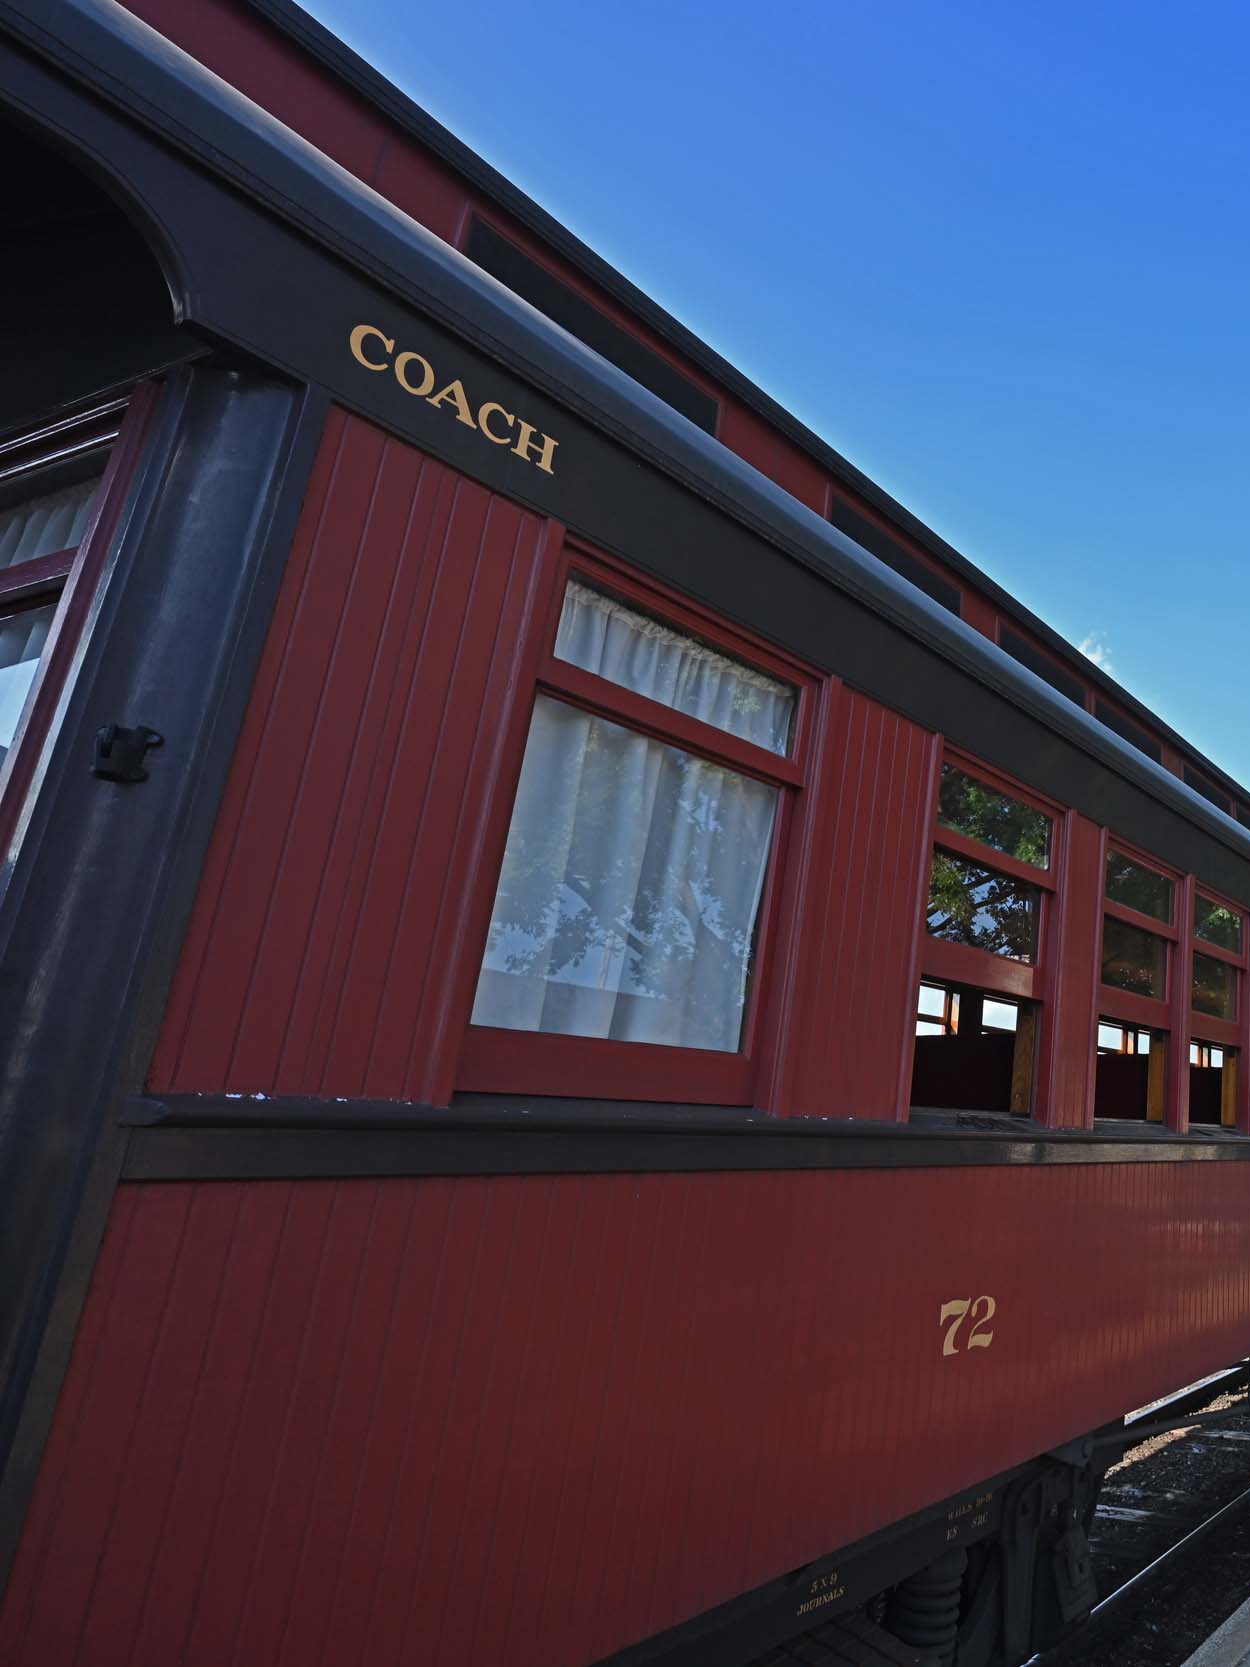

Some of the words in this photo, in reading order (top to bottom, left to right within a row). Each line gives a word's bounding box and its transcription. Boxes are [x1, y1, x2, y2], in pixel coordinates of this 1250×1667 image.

[350, 324, 559, 475] COACH
[940, 1296, 996, 1356] 72
[796, 1585, 848, 1617] JOURNALS
